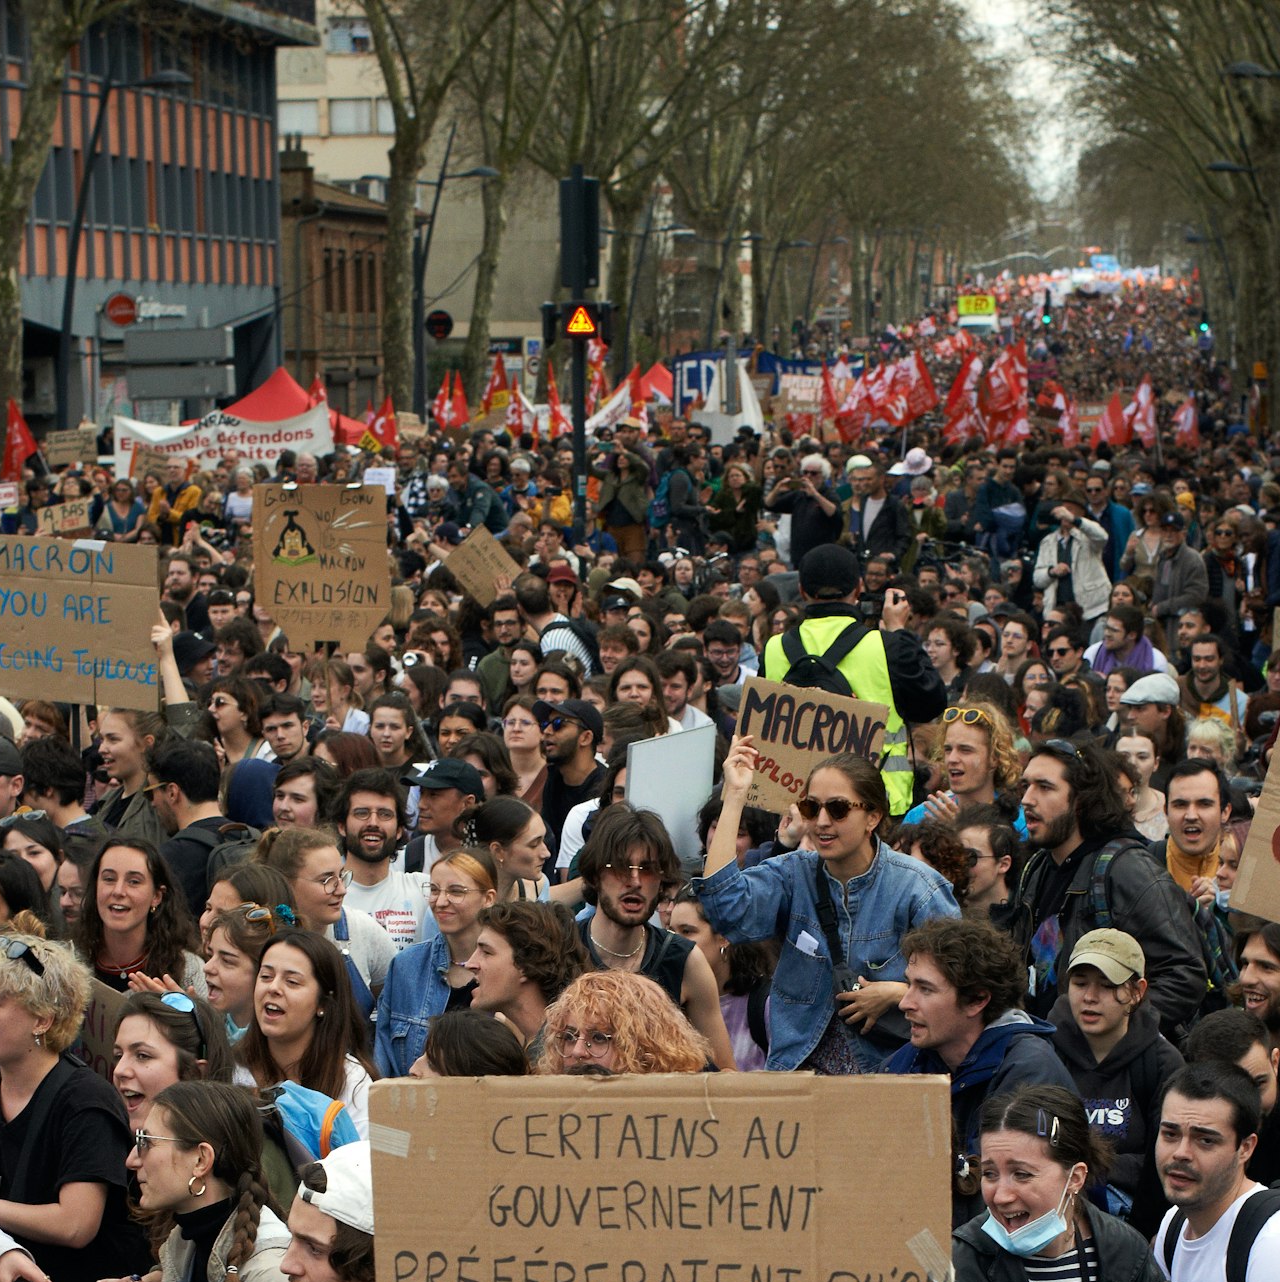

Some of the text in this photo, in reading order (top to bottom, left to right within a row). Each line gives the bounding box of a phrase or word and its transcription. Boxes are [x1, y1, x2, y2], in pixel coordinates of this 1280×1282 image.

[215, 428, 314, 447] défendons
[319, 555, 366, 572] MACRON
[63, 594, 112, 625] ARE
[1085, 1107, 1124, 1126] VI'S
[491, 1112, 801, 1161] CERTAINS AU
[487, 1179, 824, 1232] GOUVERNEMENT
